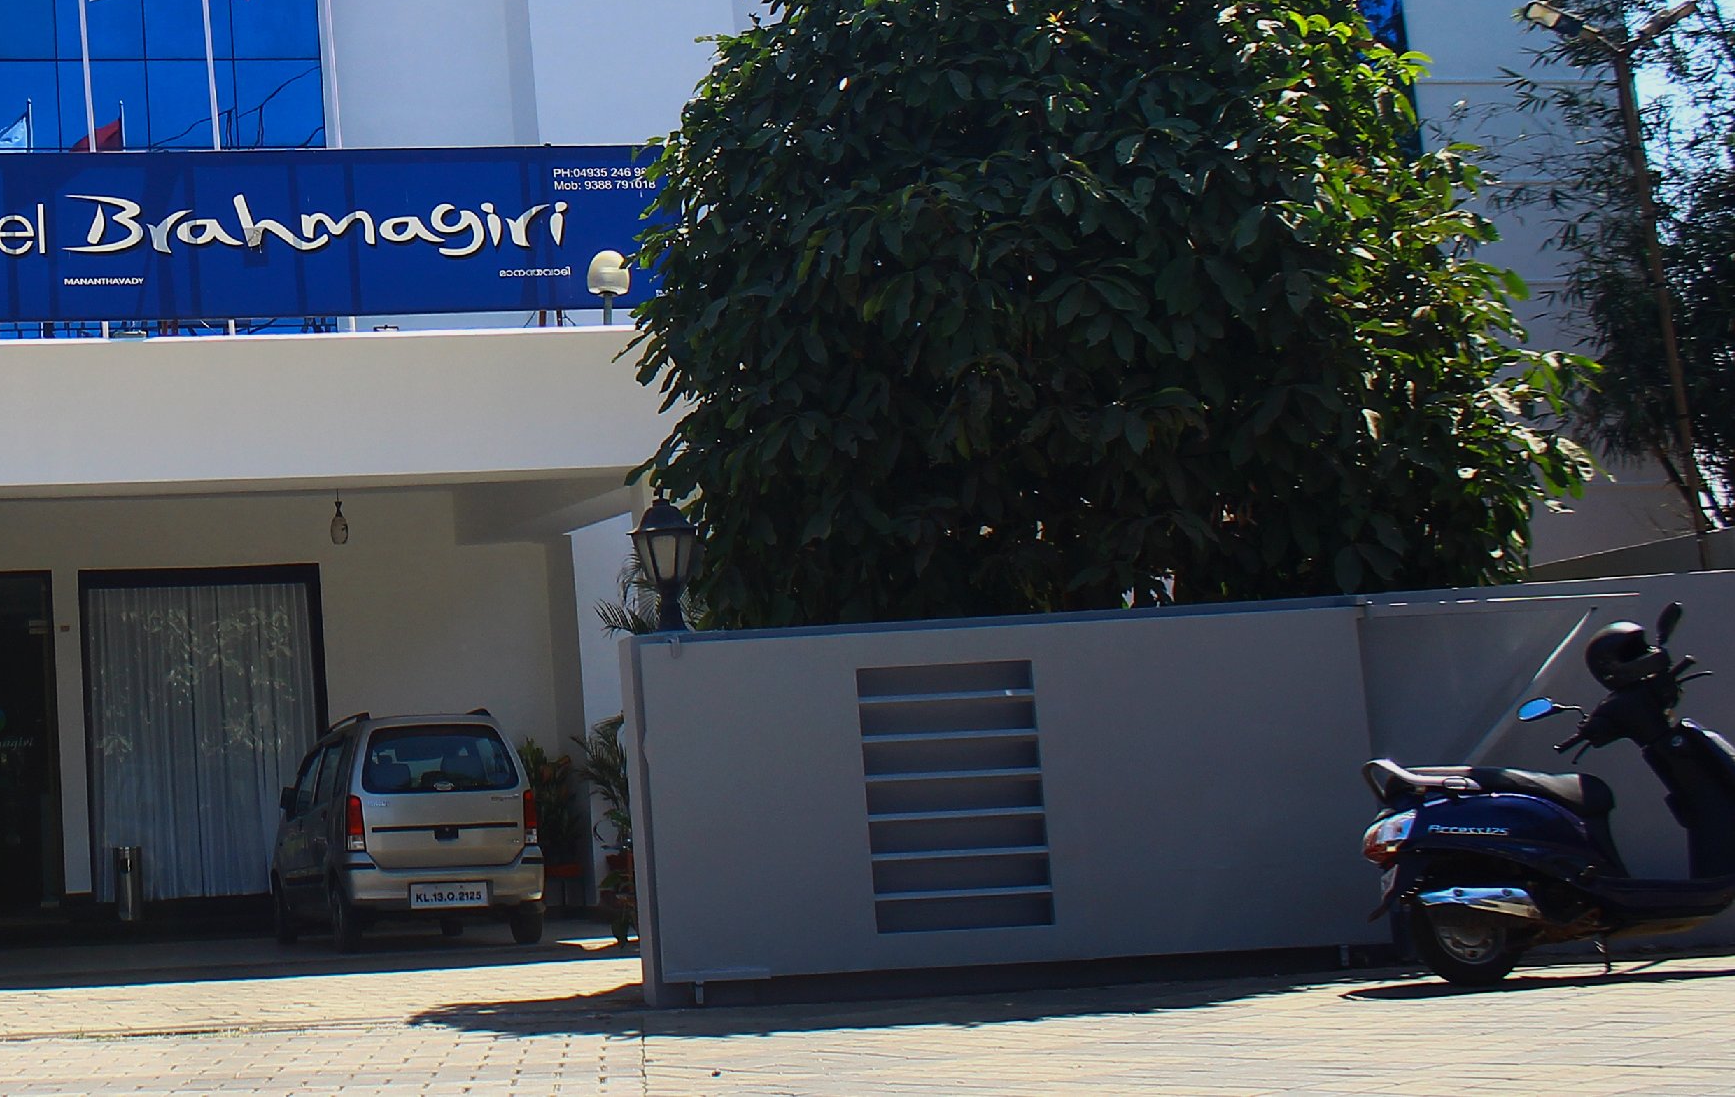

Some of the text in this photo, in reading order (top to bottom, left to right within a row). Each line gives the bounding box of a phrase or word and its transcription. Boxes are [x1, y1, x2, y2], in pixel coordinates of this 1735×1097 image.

[553, 168, 608, 178] PH:04935
[610, 167, 632, 177] 246
[554, 180, 581, 191] Mob:
[584, 180, 613, 190] 9388
[62, 194, 569, 257] Brahmagiri
[64, 277, 144, 286] MANANTHAVADY
